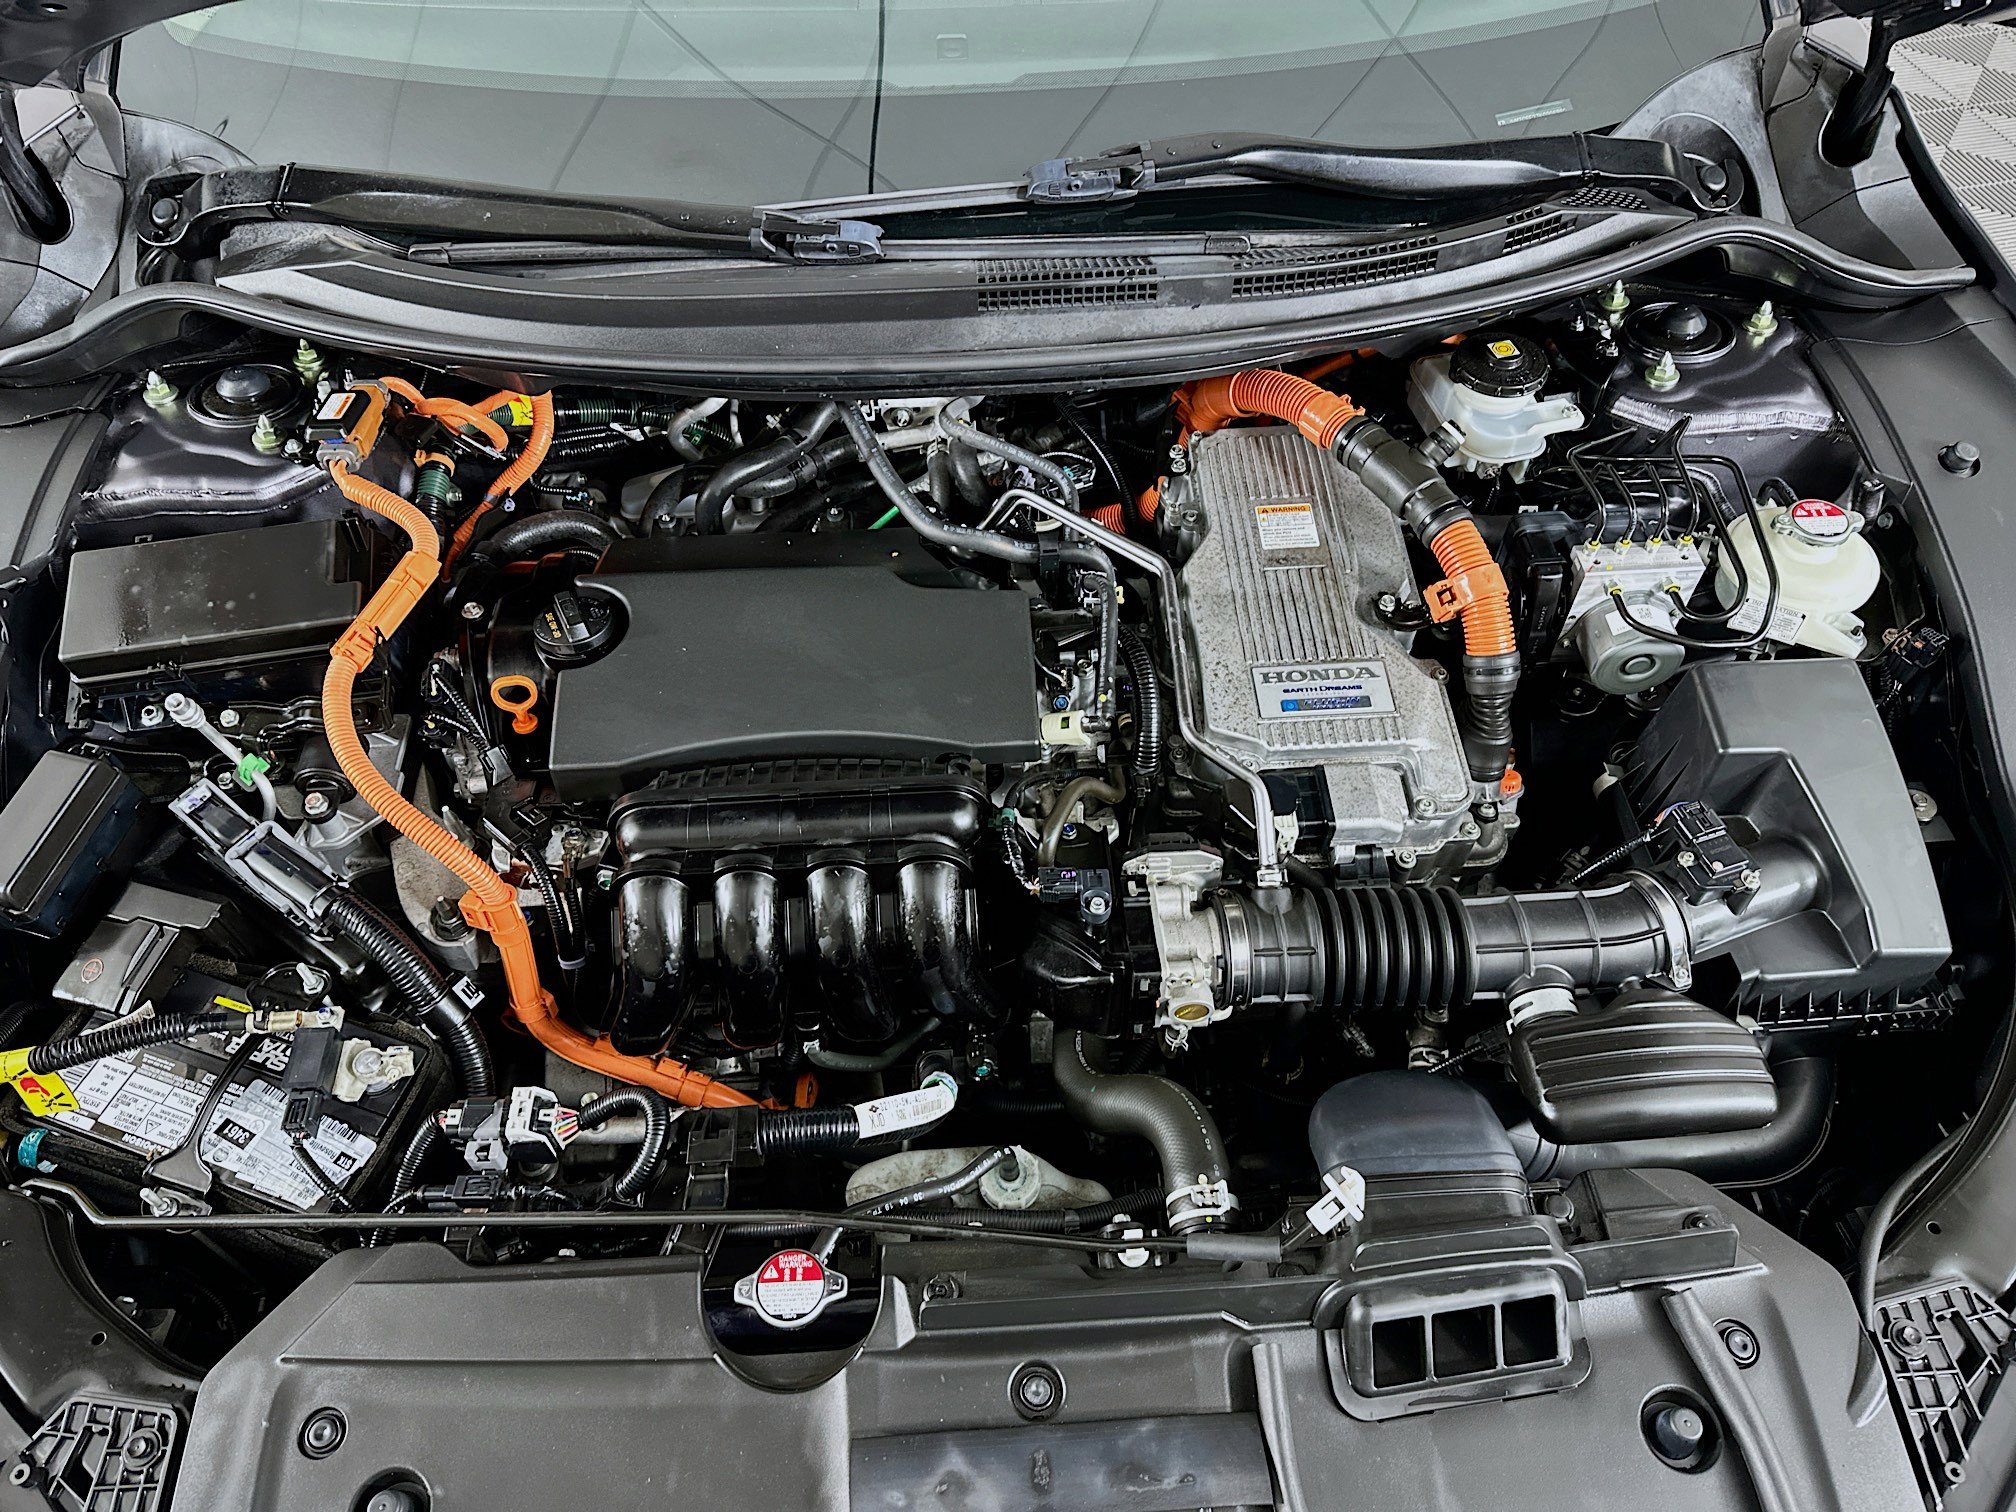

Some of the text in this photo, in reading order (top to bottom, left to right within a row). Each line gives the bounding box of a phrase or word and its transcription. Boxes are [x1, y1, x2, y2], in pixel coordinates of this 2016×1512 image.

[1260, 666, 1380, 684] HONDA
[225, 1122, 250, 1144] 3461
[309, 1138, 354, 1169] STK Roseville
[778, 1254, 807, 1262] DANGER
